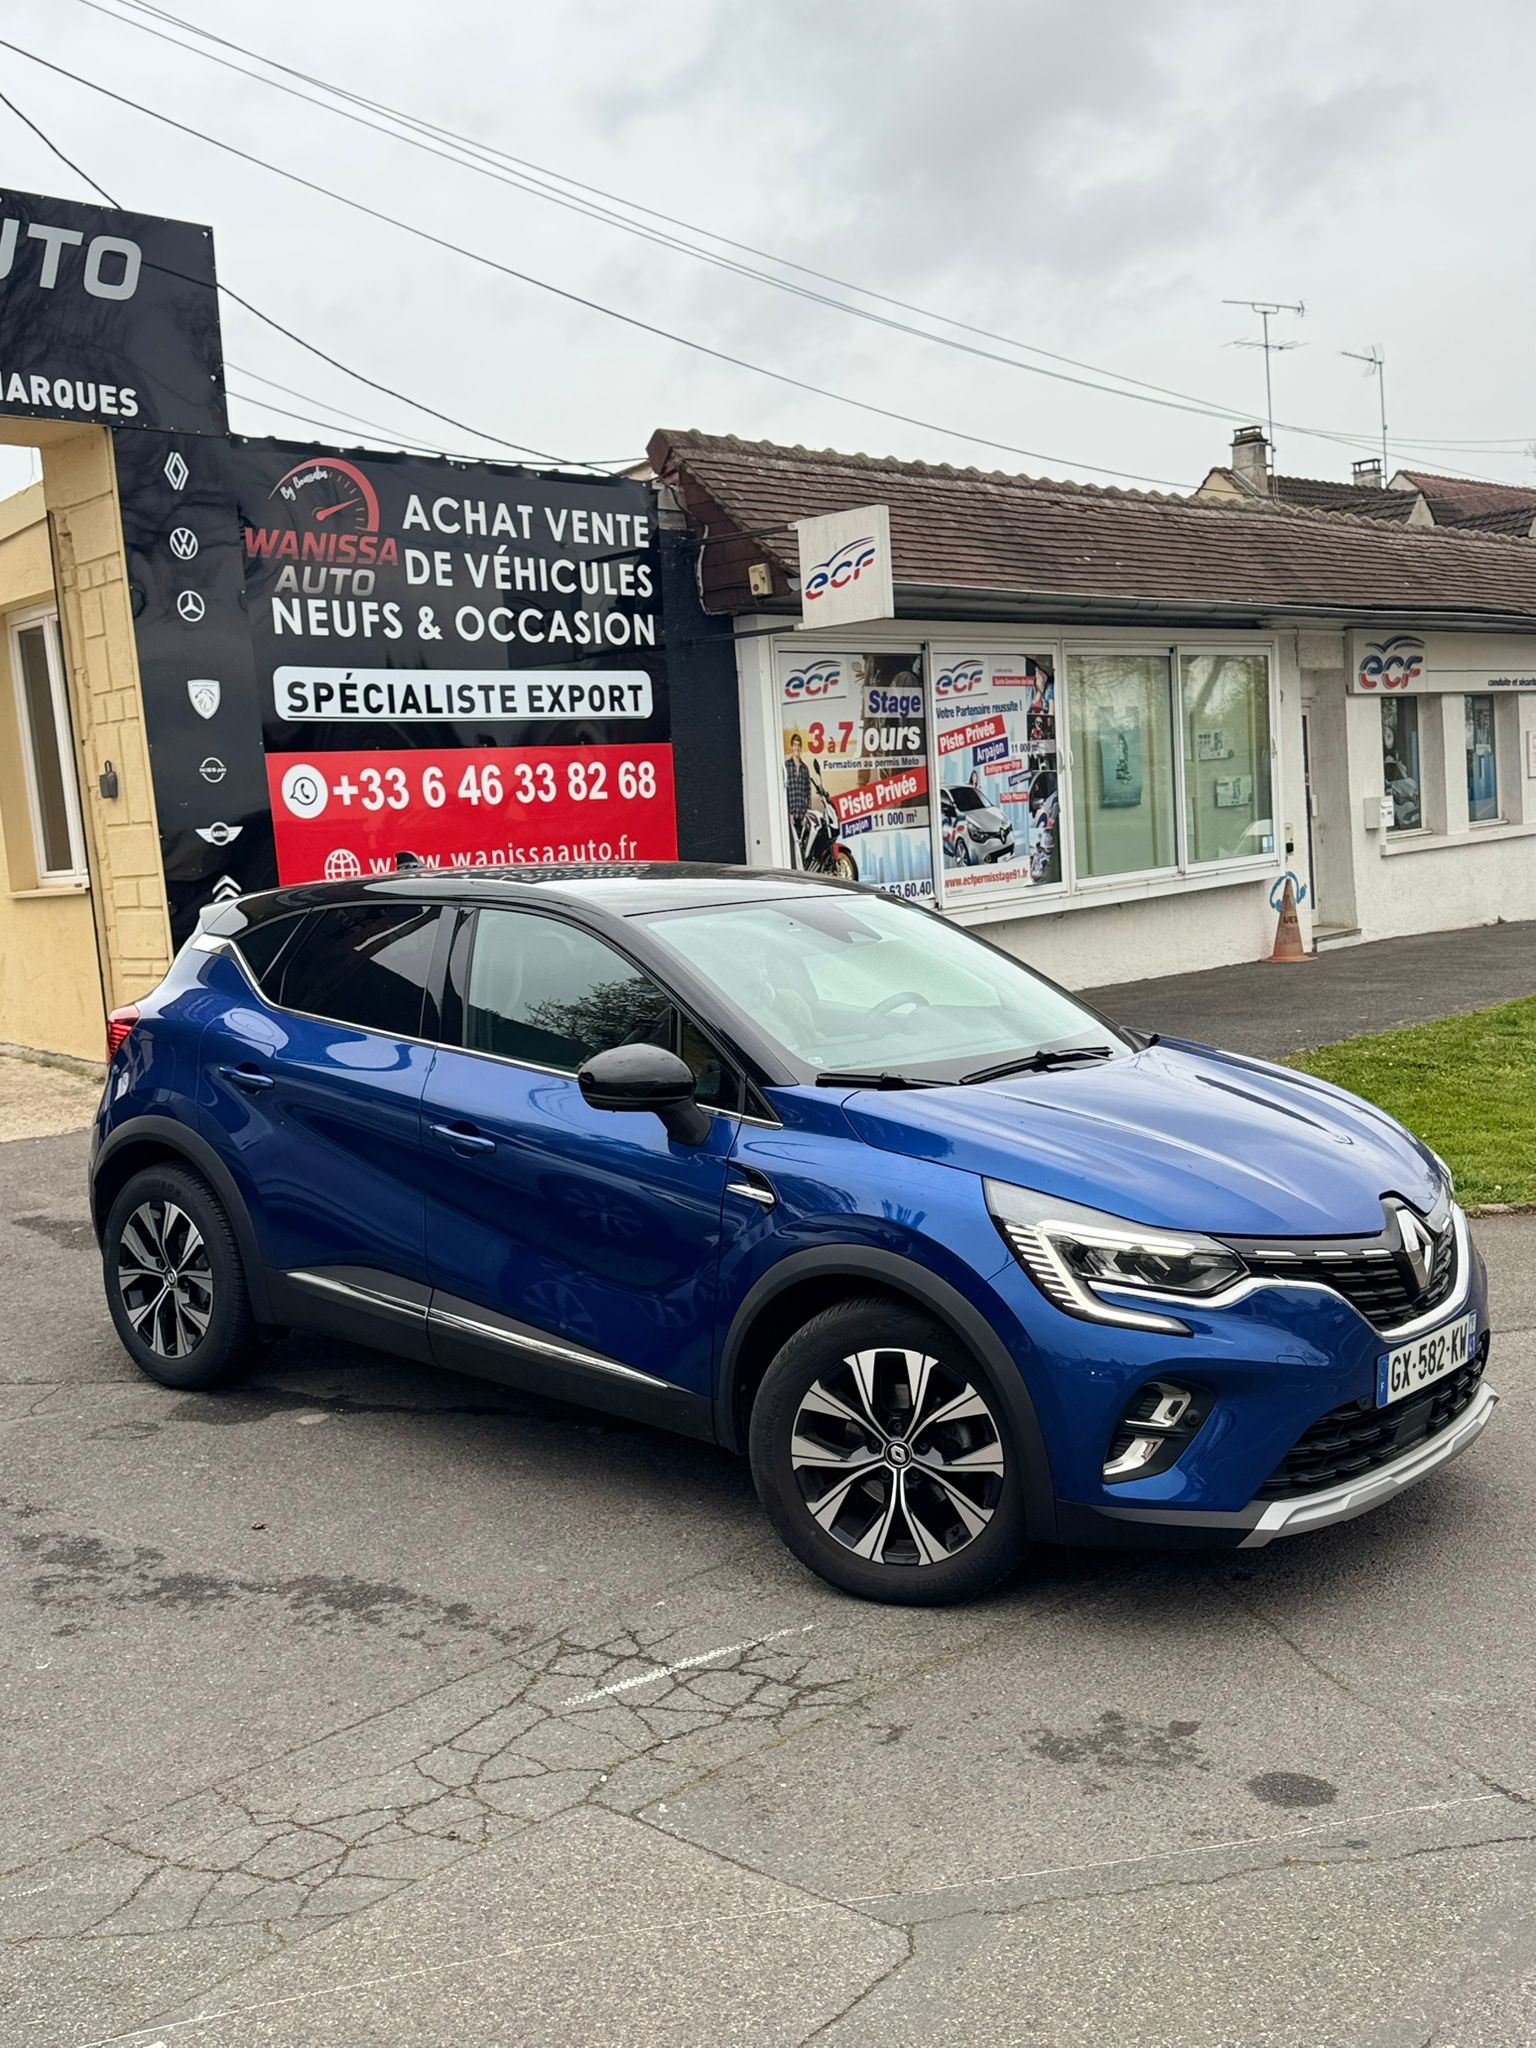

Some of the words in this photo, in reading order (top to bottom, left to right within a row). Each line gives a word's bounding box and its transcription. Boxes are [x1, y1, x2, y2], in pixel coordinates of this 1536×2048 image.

[0, 371, 138, 417] ARQUES
[402, 494, 534, 539] ACHAT
[544, 507, 650, 548] VENTE
[244, 527, 398, 566] WANISSA
[274, 565, 376, 596] AUTO
[404, 549, 453, 586] DE
[464, 545, 654, 598] VÉHICULES
[272, 597, 404, 639] NEUFS
[418, 605, 443, 640] &
[455, 605, 655, 646] OCCASION
[287, 673, 518, 714] SPÉCIALISTE
[528, 684, 643, 713] EXPORT
[868, 690, 922, 718] Stage
[936, 706, 955, 719] Votre
[956, 703, 991, 716] Partenaire
[808, 721, 826, 754] 3
[828, 736, 837, 754] à
[838, 720, 854, 753] 7
[939, 733, 965, 753] Piste
[965, 721, 996, 743] Privée
[977, 741, 1005, 762] Arpajon
[823, 759, 862, 769] Formation
[863, 760, 873, 768] au
[875, 758, 900, 769] permis
[901, 757, 920, 766] Moto
[333, 767, 410, 811] +33
[422, 766, 446, 809] 6
[458, 764, 504, 806] 46
[514, 762, 557, 804] 33
[568, 761, 608, 801] 82
[618, 760, 656, 800] 68
[838, 791, 874, 819] Piste
[875, 774, 918, 805] Privée
[844, 817, 870, 837] Arpajon
[874, 814, 884, 827] 11
[888, 812, 904, 825] 000
[1391, 1322, 1468, 1393] GX-582-KW
